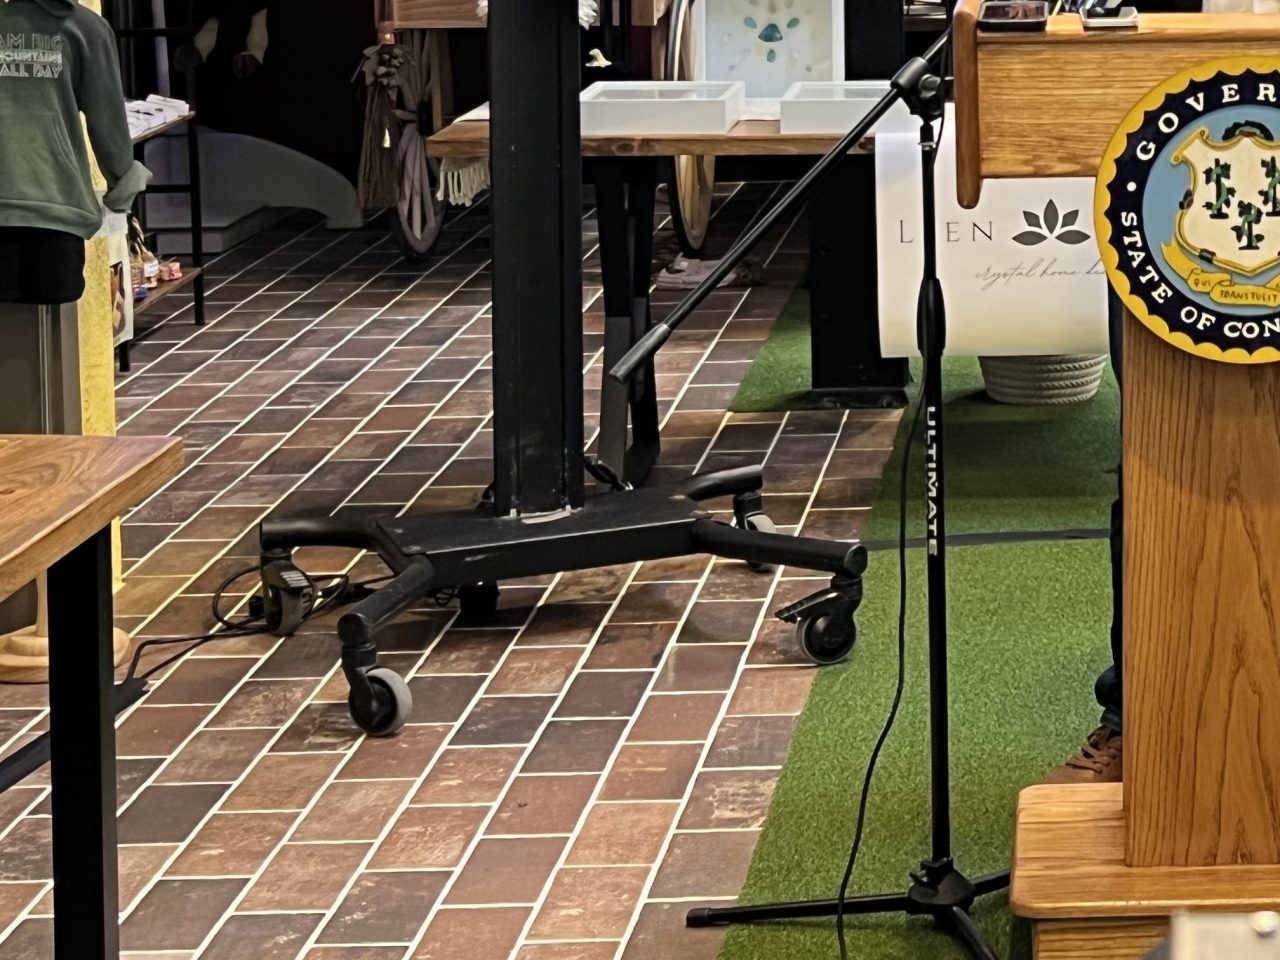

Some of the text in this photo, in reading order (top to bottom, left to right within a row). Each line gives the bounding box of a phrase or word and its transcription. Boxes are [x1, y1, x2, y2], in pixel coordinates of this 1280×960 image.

[899, 219, 993, 244] LEN
[1120, 210, 1173, 306] STATE
[1180, 305, 1216, 332] OF
[925, 405, 939, 557] ULTIMATE
